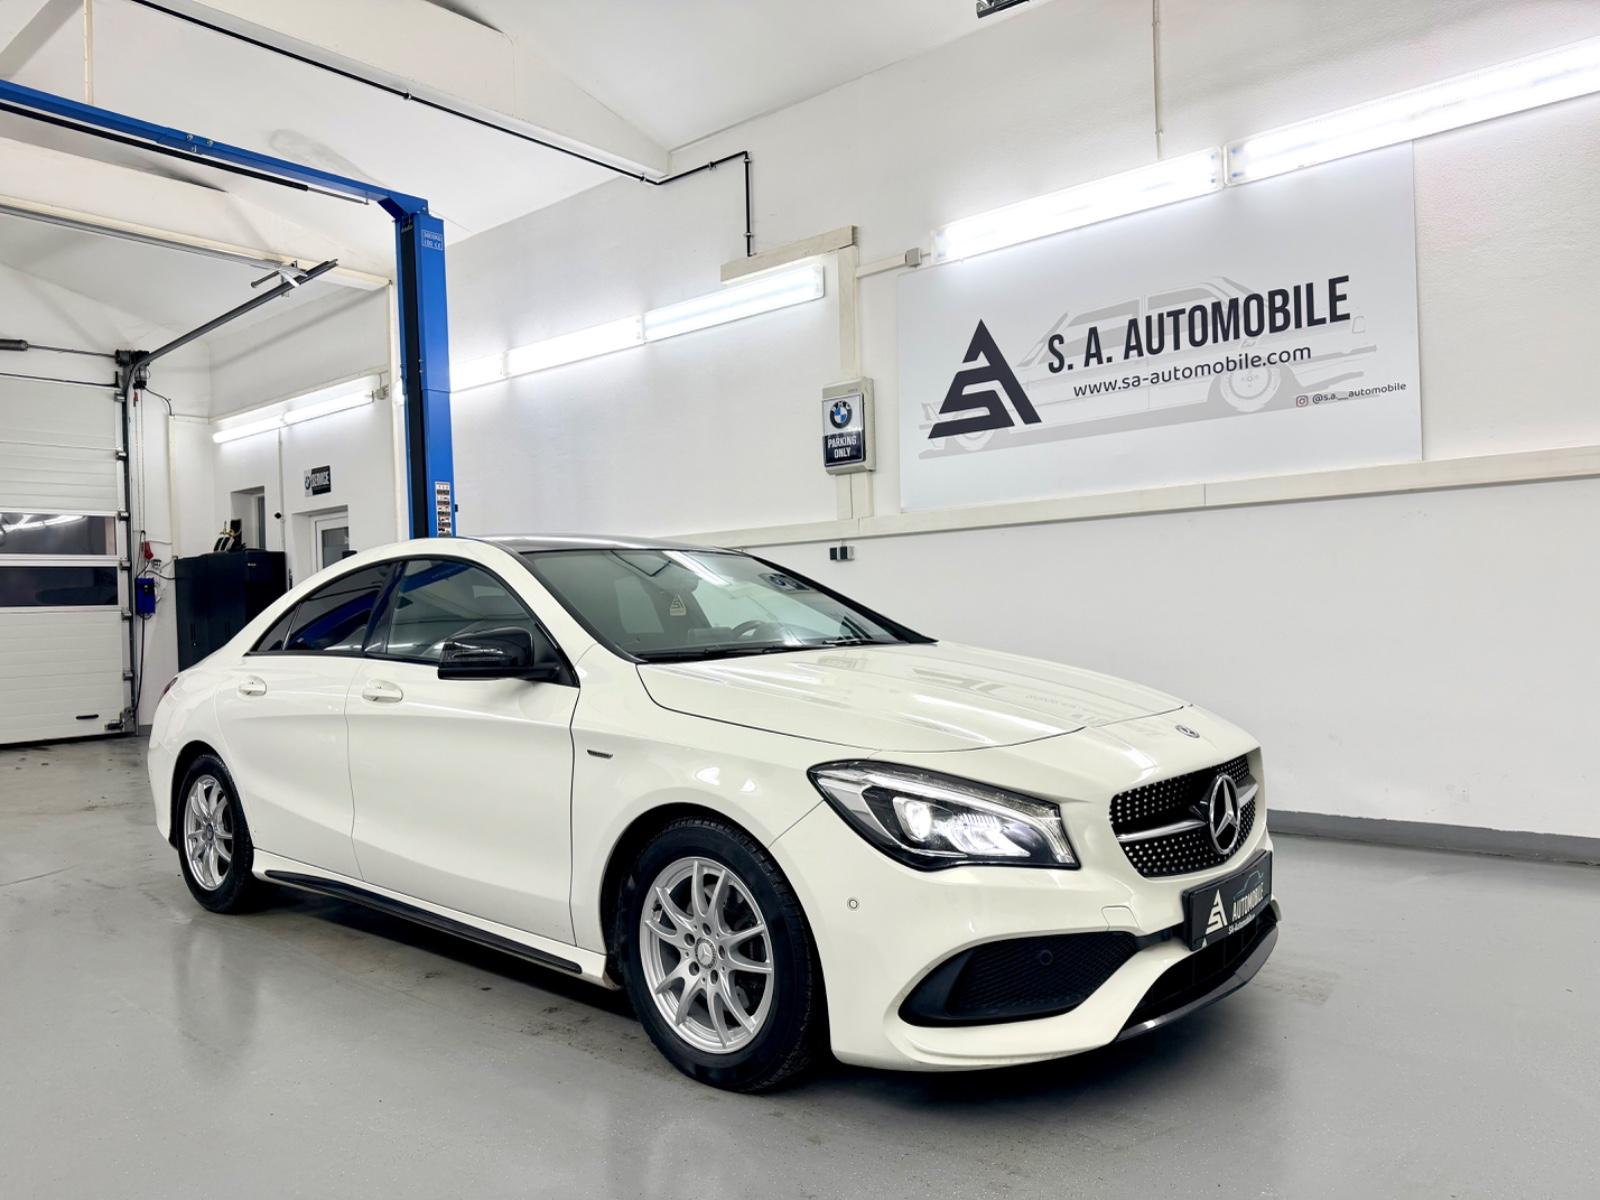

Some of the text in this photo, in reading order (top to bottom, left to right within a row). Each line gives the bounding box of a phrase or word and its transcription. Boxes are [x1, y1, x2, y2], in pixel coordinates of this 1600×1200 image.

[1047, 274, 1351, 374] S. A. AUTOMOBILE
[1073, 343, 1312, 398] www.sa-automobile.com
[827, 435, 857, 449] PARKING
[834, 446, 851, 459] ONLY
[1232, 882, 1264, 922] AUTOMOBILE
